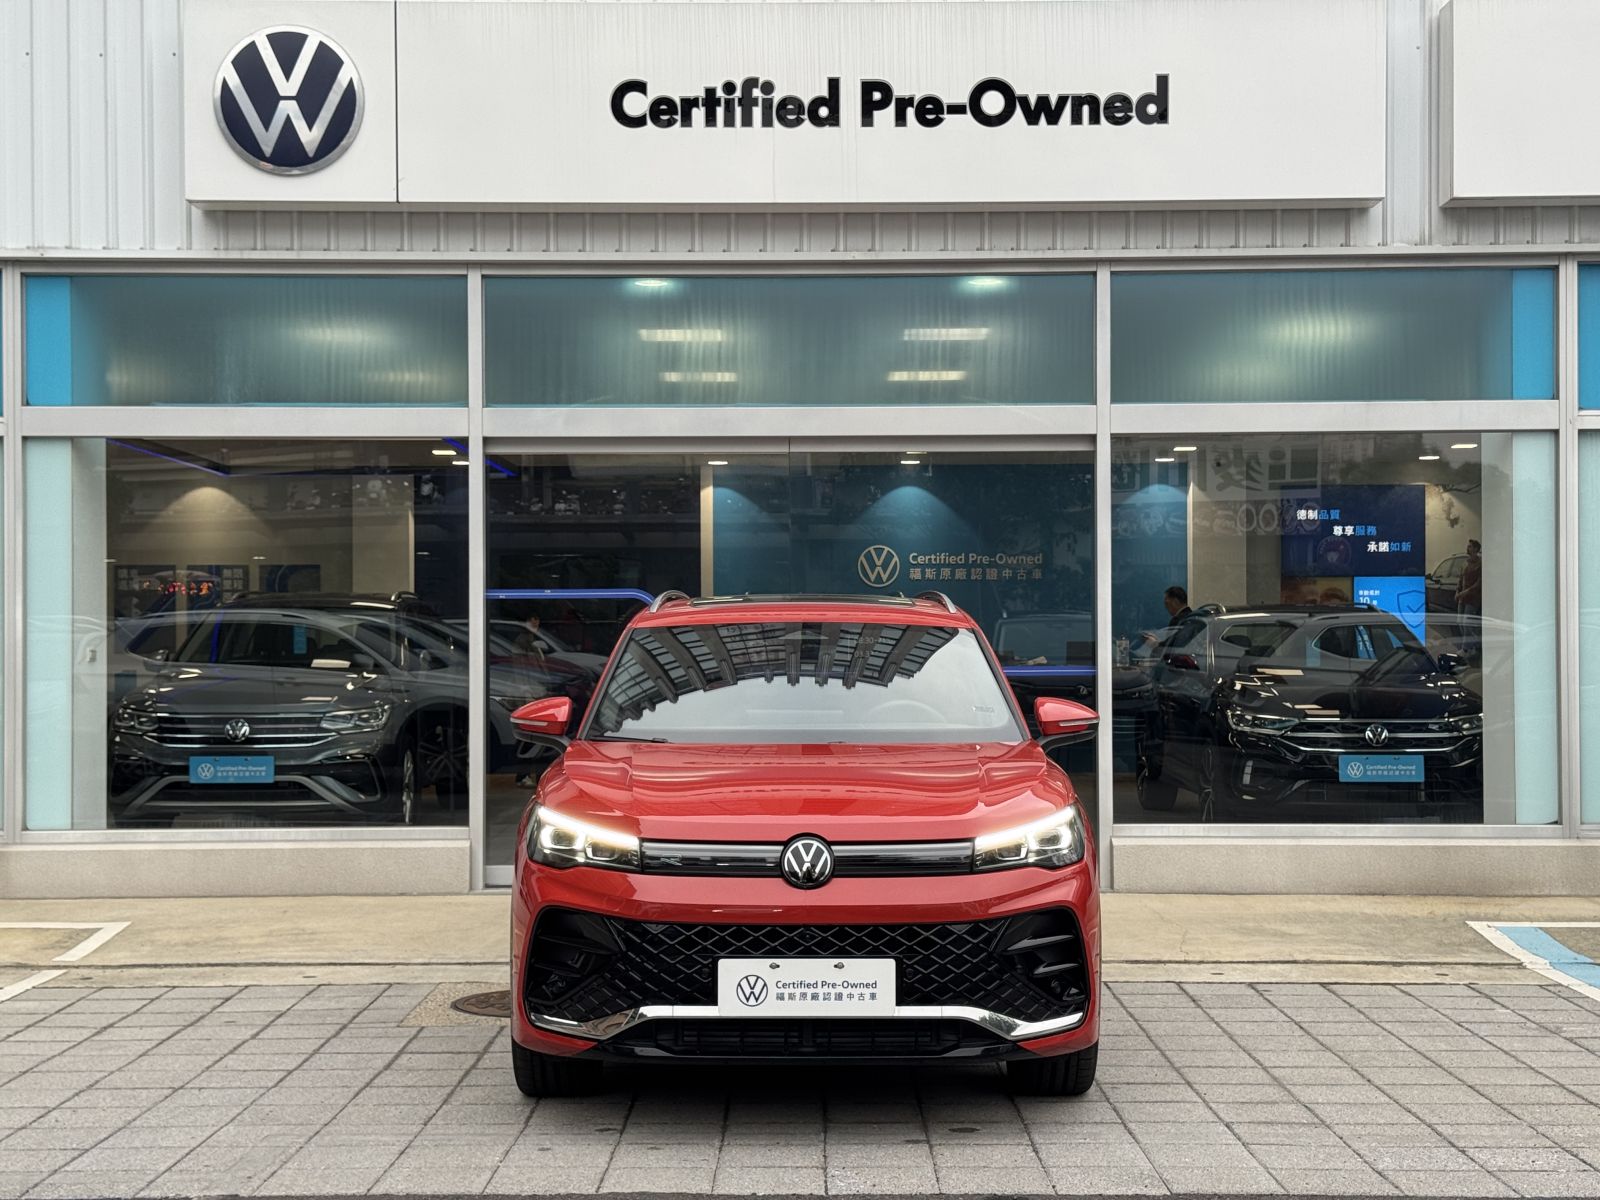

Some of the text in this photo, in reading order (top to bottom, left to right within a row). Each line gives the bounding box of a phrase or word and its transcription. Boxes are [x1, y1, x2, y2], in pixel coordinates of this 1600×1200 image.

[216, 27, 362, 172] VW
[610, 73, 1169, 128] Certified Pre-Owned
[1332, 525, 1377, 537] 尊享服務
[1367, 541, 1412, 553] 承諾如新
[909, 553, 1042, 564] Certified Pre-Owned
[858, 545, 900, 587] VW
[909, 568, 1042, 581] 福斯原廠認證中古車
[775, 980, 878, 989] Certified Pre-Owned
[736, 975, 768, 1007] VW
[775, 992, 878, 1001] 福斯原廠認證中古車
